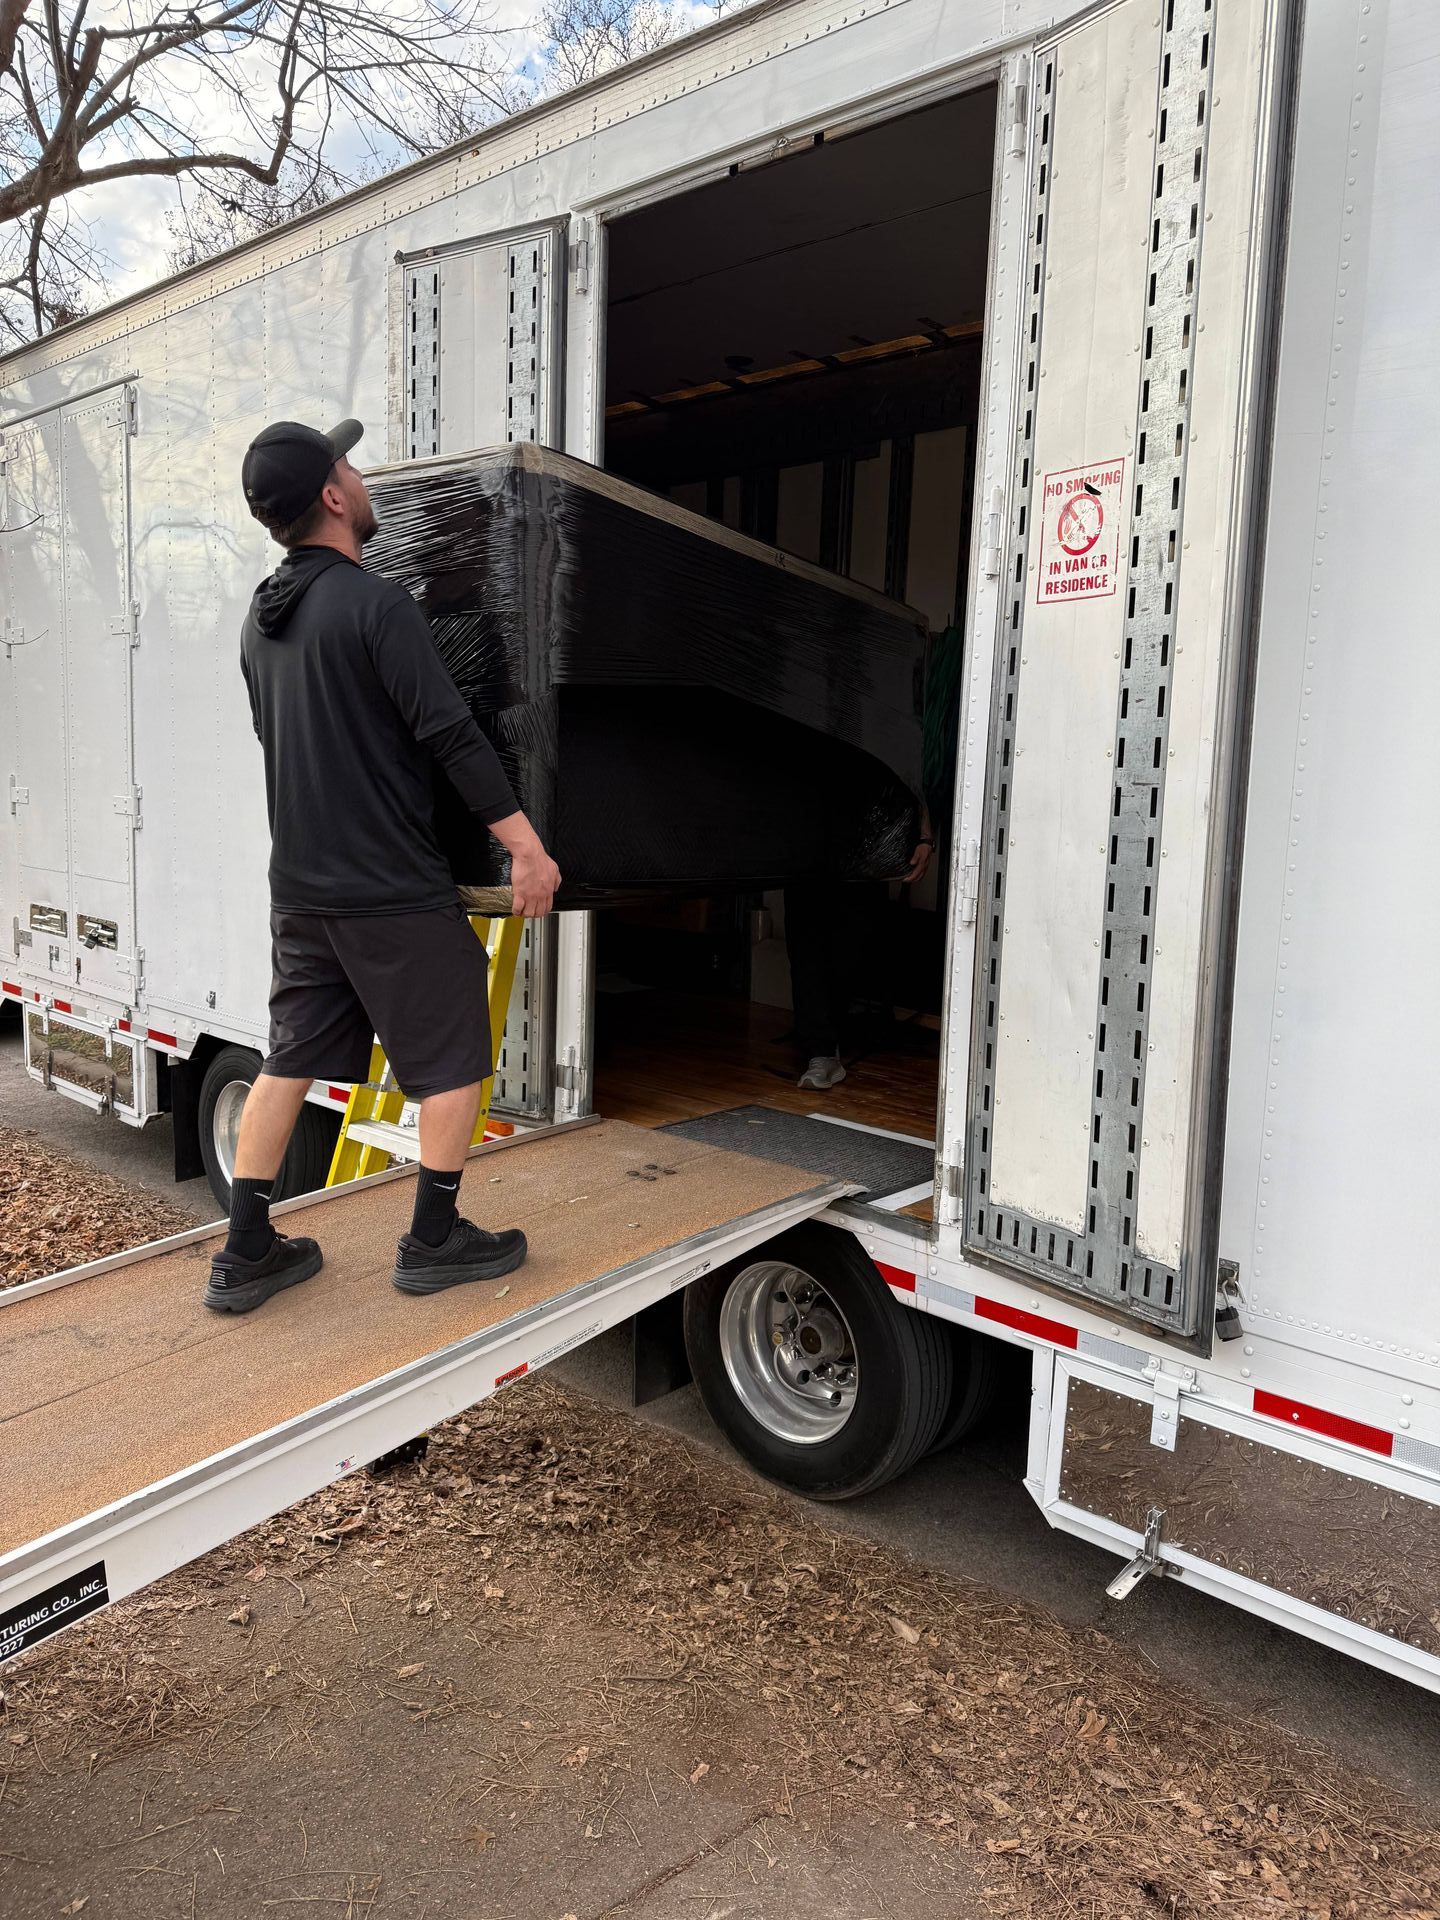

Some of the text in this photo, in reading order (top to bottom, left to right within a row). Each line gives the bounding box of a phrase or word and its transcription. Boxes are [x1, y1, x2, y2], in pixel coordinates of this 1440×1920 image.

[1046, 482, 1063, 497] NO
[1049, 561, 1062, 575] IN
[1065, 556, 1088, 573] VAN
[1045, 574, 1109, 595] RESIDENCE
[0, 1579, 103, 1640] TURING CO., INC.
